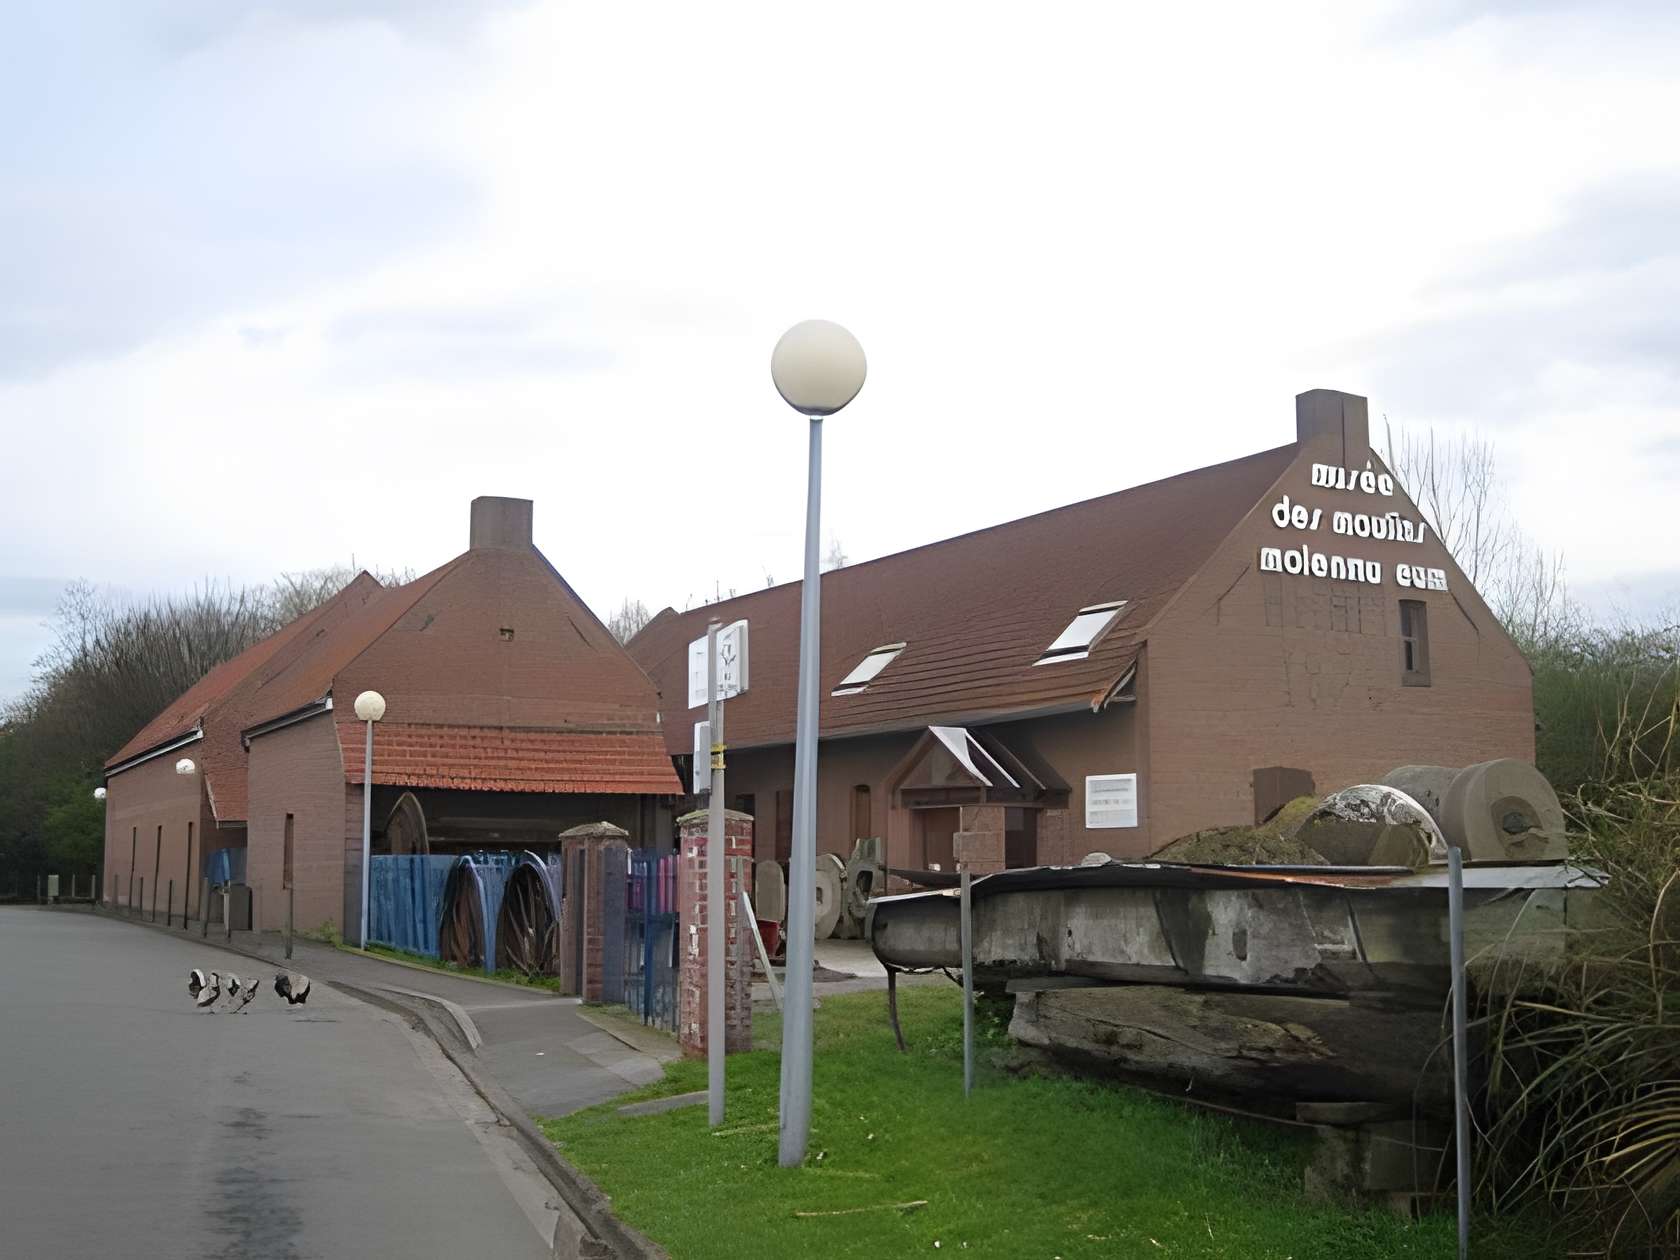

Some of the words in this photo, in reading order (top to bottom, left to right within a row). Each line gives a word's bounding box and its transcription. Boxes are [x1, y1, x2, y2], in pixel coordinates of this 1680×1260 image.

[1311, 460, 1393, 496] musée
[1272, 495, 1322, 530] des
[1332, 511, 1425, 544] moulins
